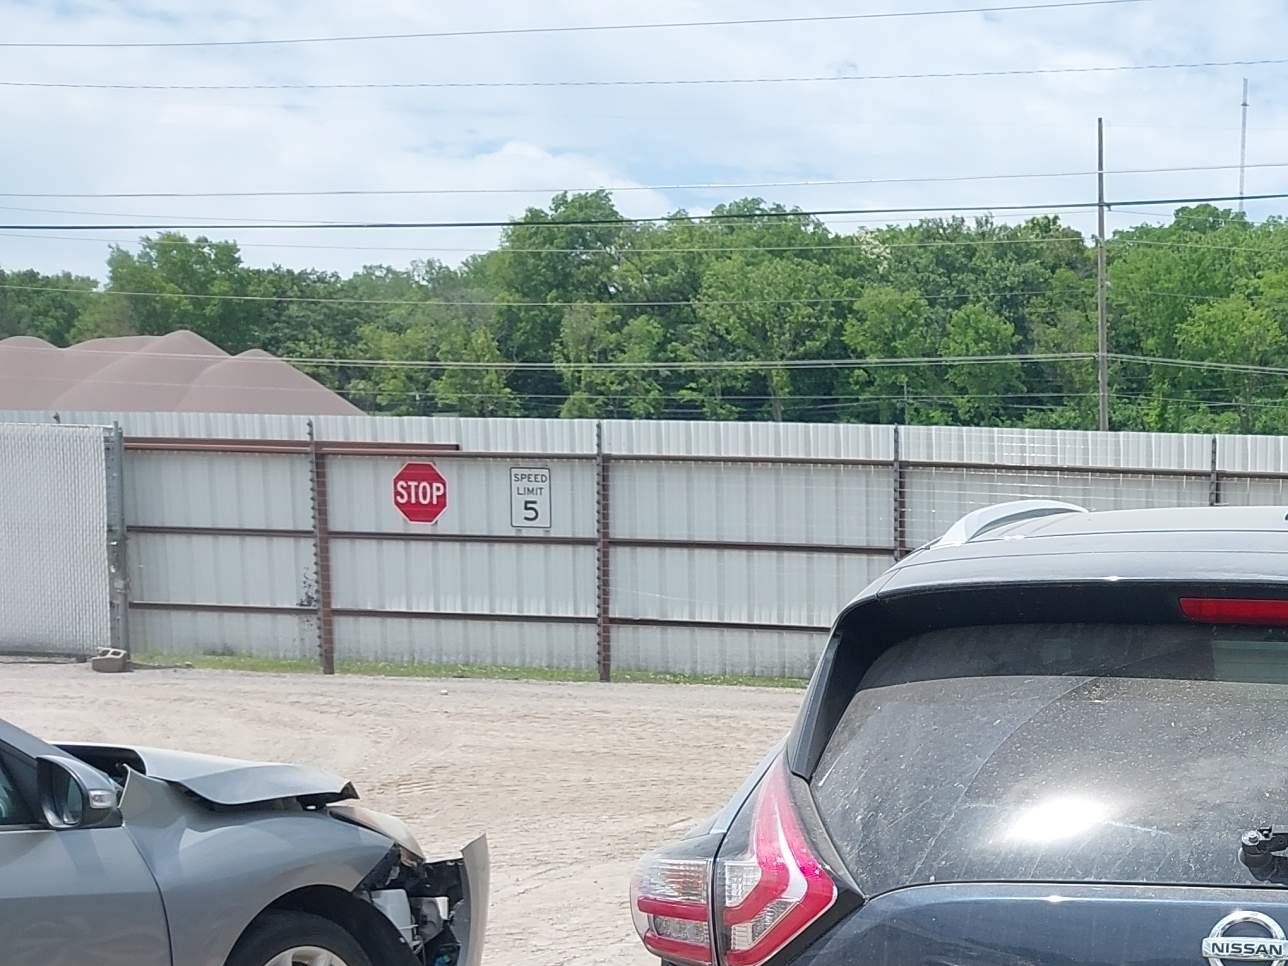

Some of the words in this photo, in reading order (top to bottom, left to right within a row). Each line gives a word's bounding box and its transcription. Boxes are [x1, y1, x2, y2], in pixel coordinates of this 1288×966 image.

[513, 473, 548, 484] SPEED
[396, 480, 445, 505] STOP
[517, 487, 545, 496] LIMIT
[523, 500, 539, 522] 5
[1211, 942, 1283, 956] NISSAN
